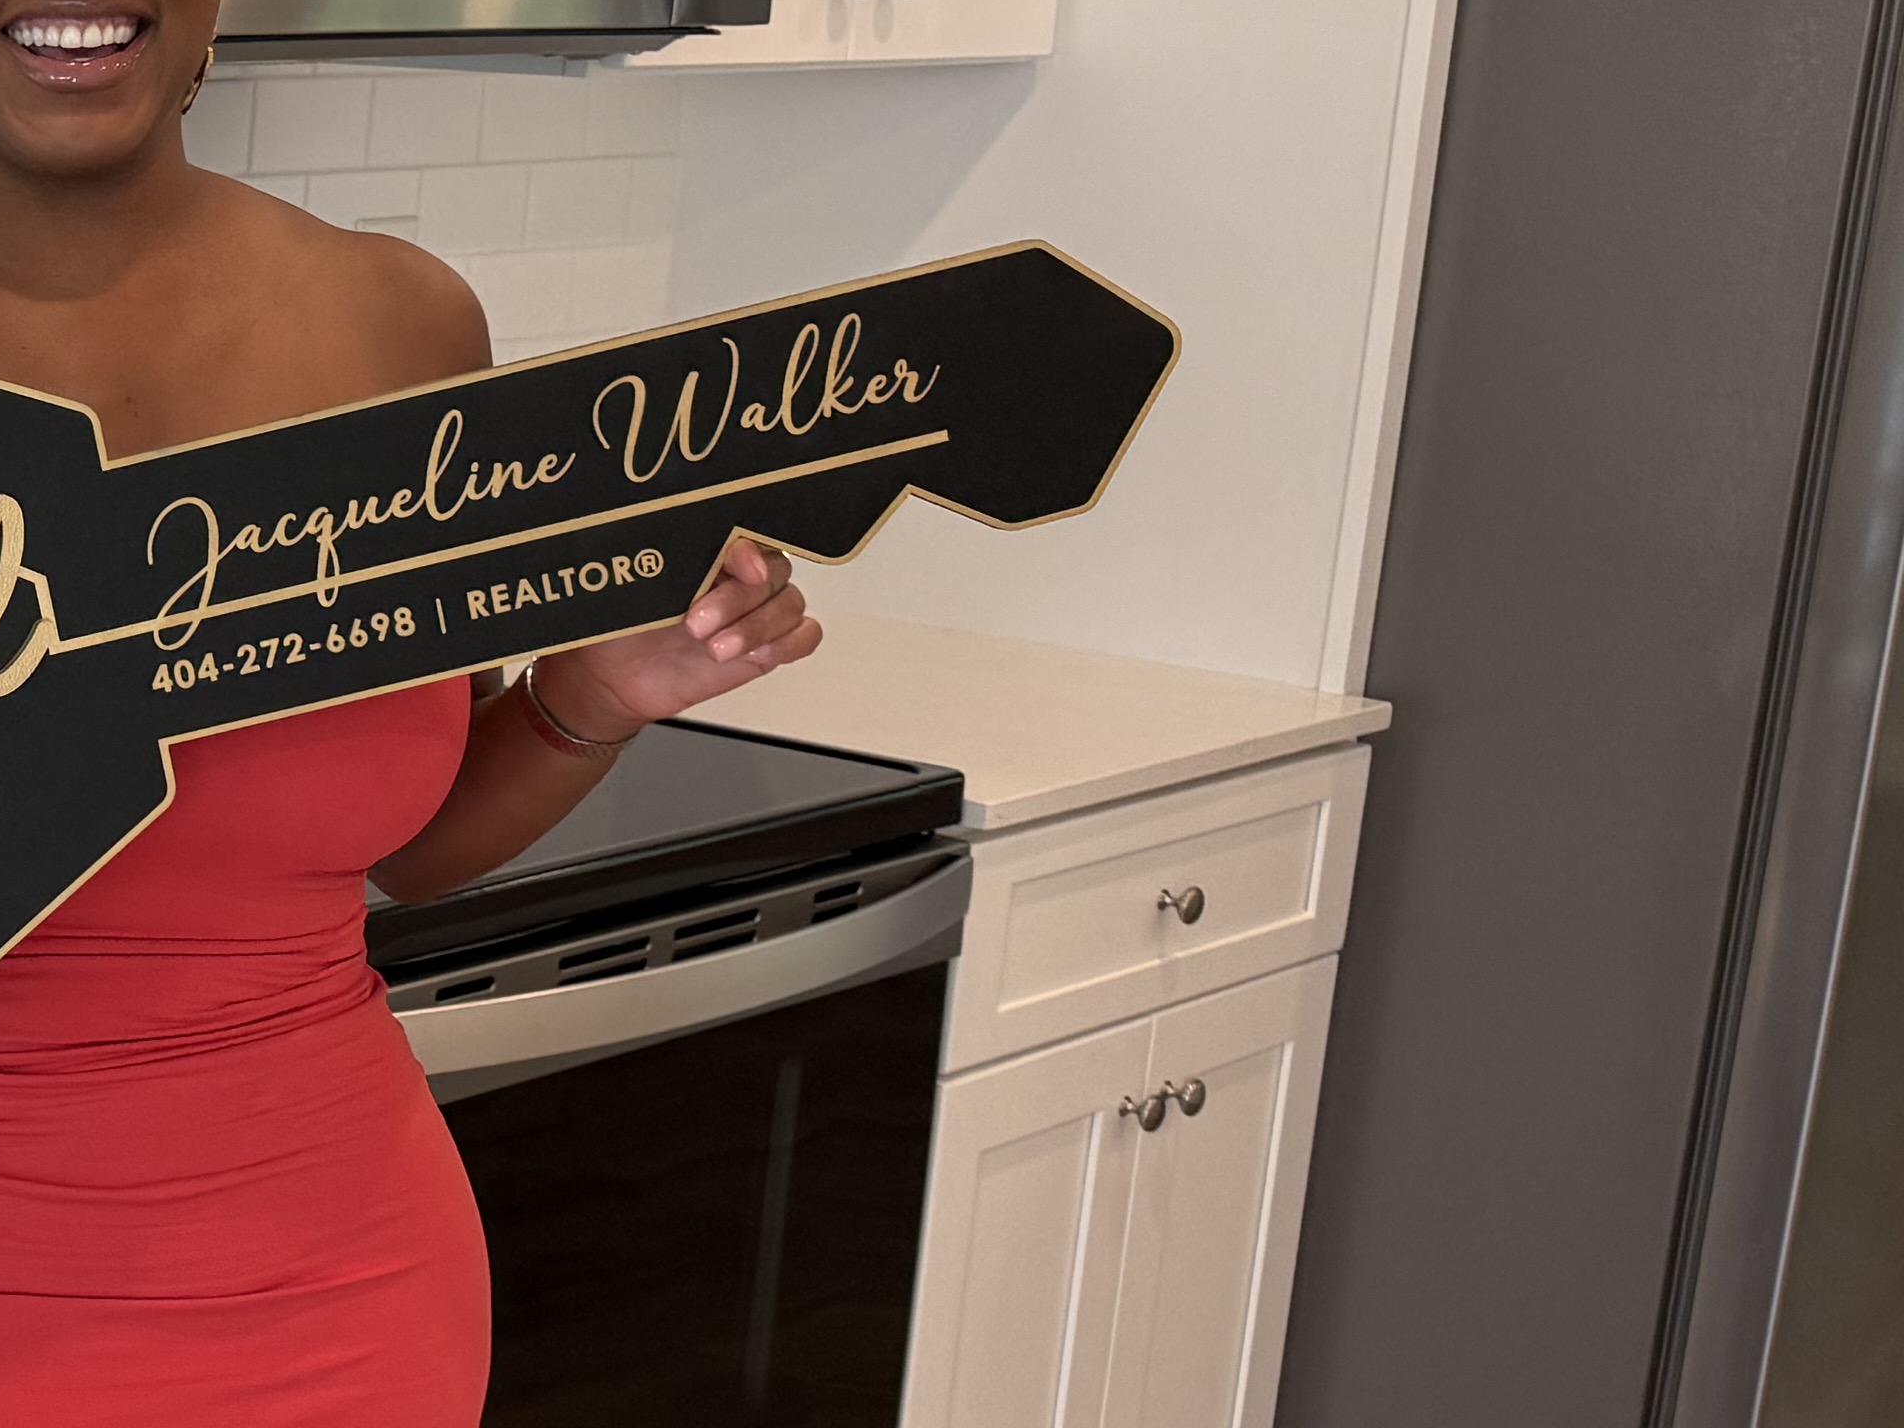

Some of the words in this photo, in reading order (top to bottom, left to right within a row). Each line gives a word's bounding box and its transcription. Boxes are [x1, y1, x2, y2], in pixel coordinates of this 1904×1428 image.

[147, 409, 576, 651] Jacqueline
[591, 312, 941, 483] Walker
[151, 606, 418, 695] 404-272-6698
[466, 547, 665, 621] REALTOR®
